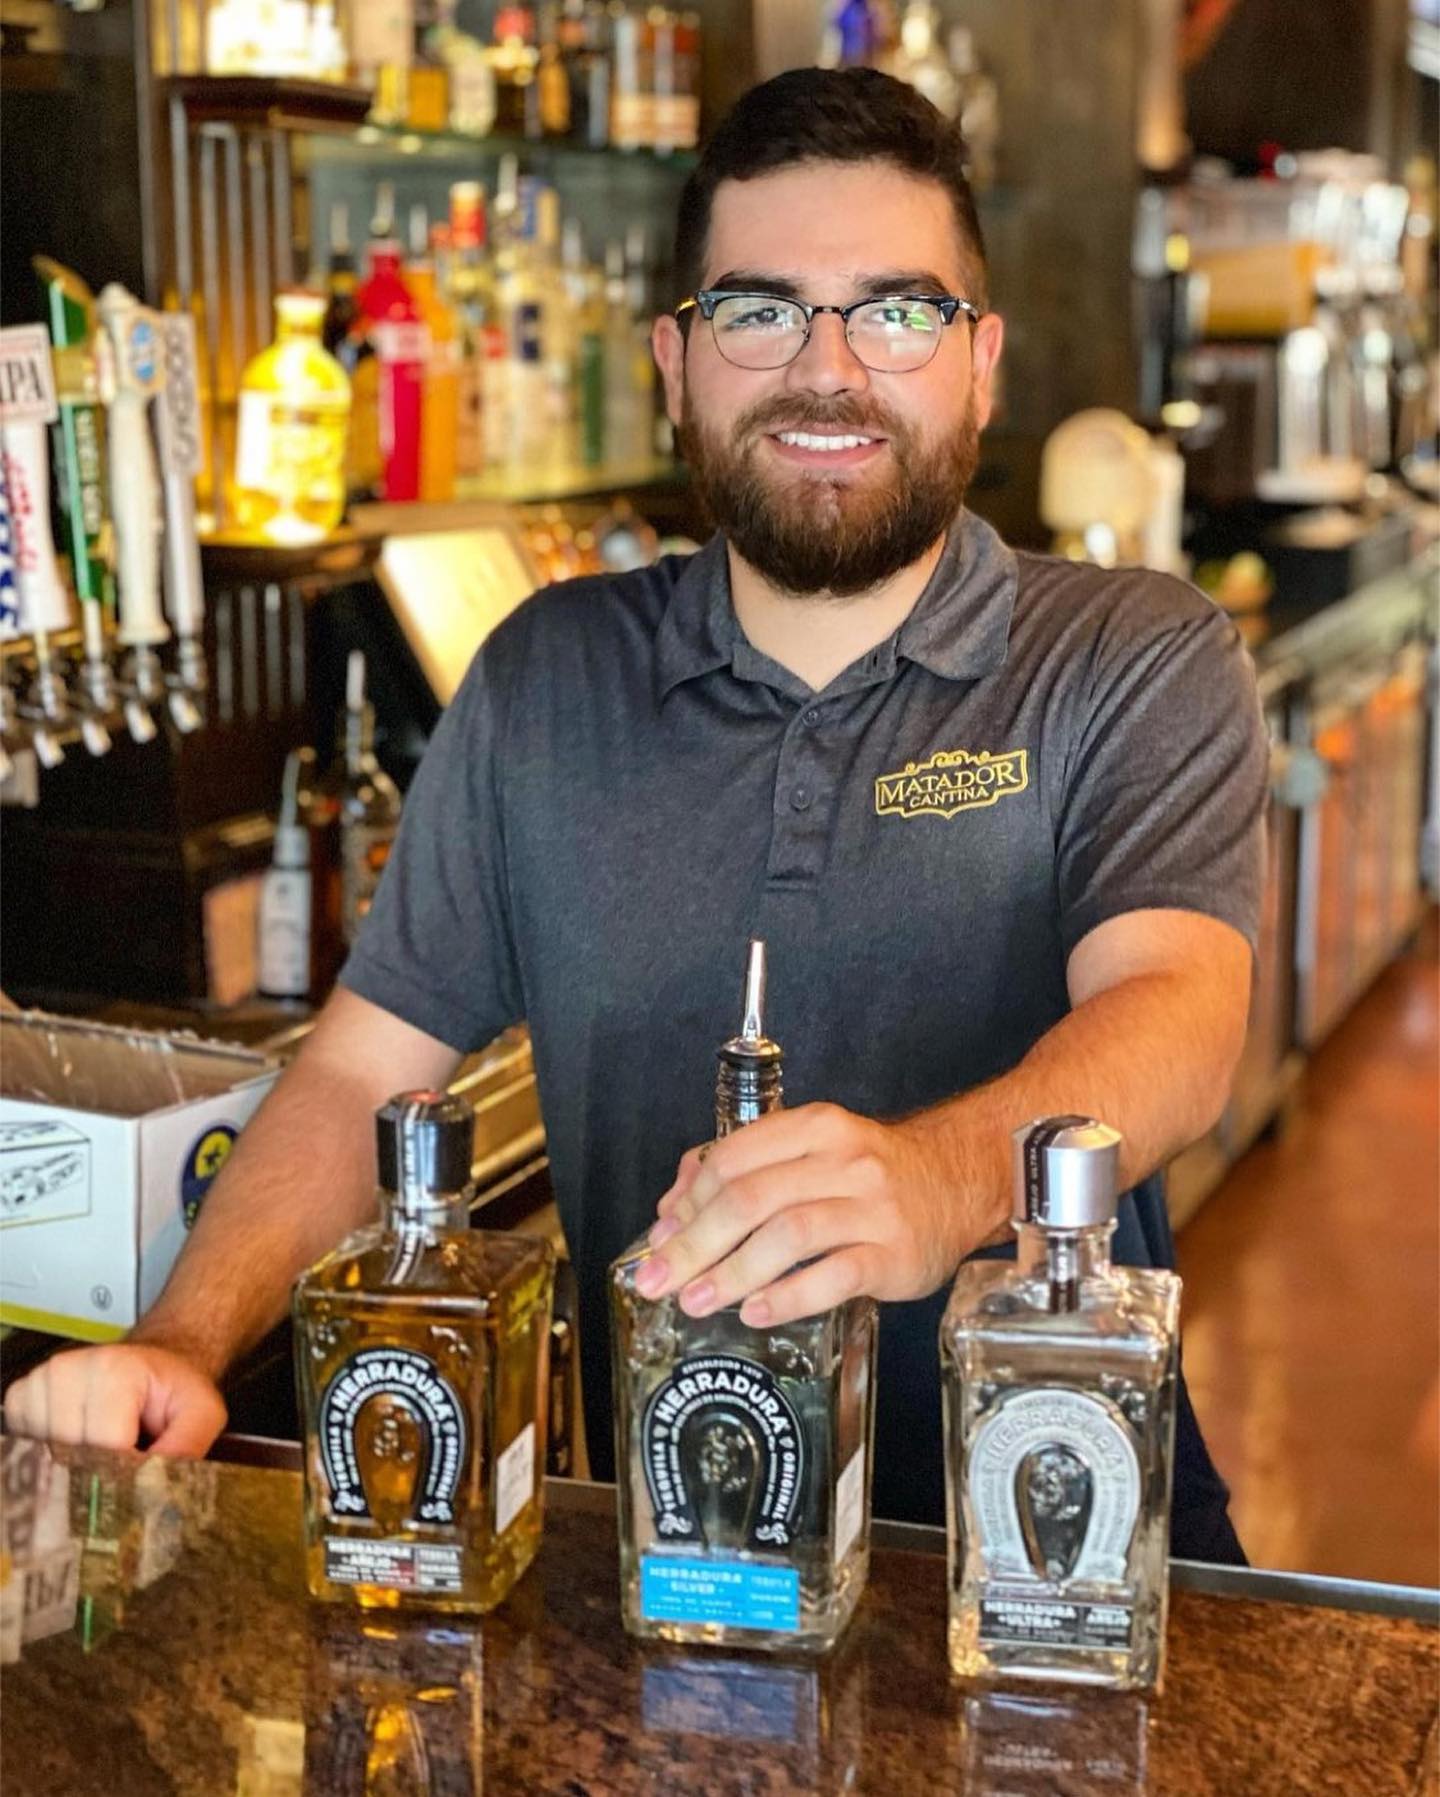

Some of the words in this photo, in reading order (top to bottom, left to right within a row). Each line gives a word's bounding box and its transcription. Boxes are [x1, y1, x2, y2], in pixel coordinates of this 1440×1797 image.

[880, 761, 1020, 806] MATADOR
[909, 786, 989, 808] CANTINA
[331, 1361, 454, 1422] HERRADURA
[654, 1371, 791, 1434] HERRADURA
[329, 1426, 351, 1490] TEQUILA
[435, 1436, 458, 1499] ORIGINAL
[986, 1407, 1124, 1470] HERRADURA
[652, 1441, 677, 1511] TEQUILA
[771, 1452, 796, 1520] ORIGINAL
[328, 1542, 412, 1559] HERRADURA
[649, 1567, 742, 1583] HERRADURA
[670, 1581, 715, 1594] SILVER
[984, 1601, 1076, 1618] HERRADURA
